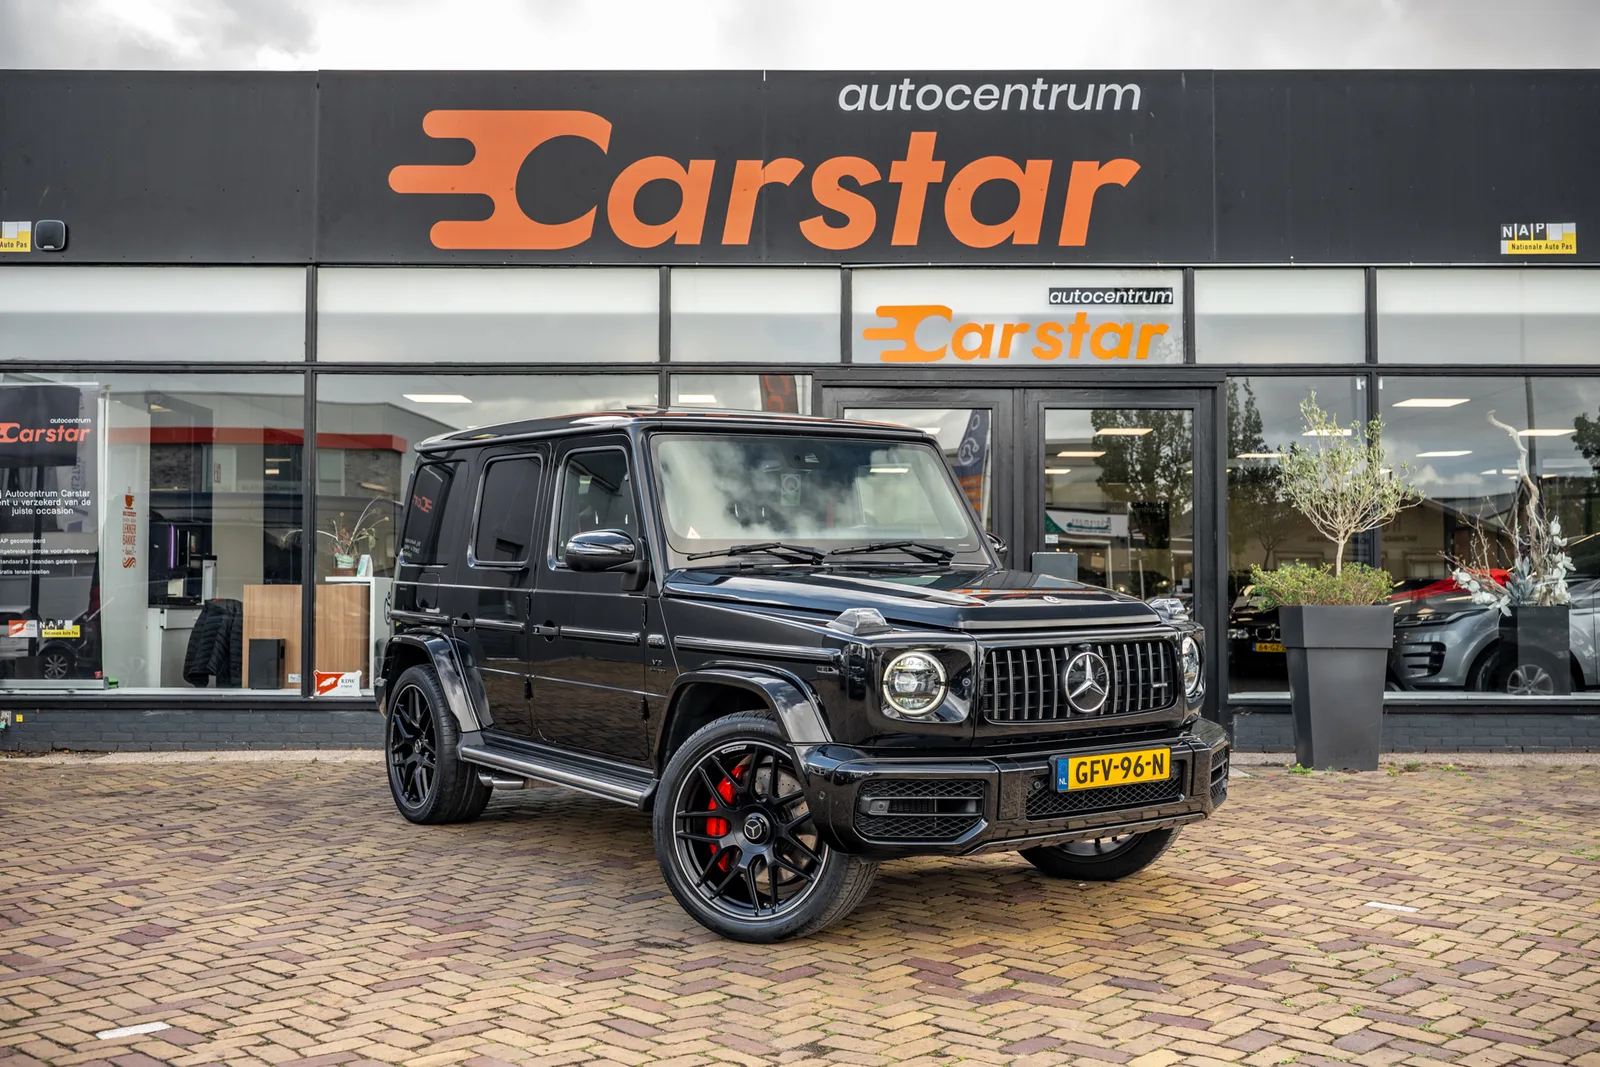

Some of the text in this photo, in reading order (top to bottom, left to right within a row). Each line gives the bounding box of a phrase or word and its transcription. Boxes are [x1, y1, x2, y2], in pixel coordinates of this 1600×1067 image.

[838, 77, 1141, 112] autocentrum
[389, 109, 1140, 251] Carstar
[16, 241, 28, 249] Pas
[1561, 242, 1573, 250] Pas
[1049, 289, 1173, 304] autocentrum
[862, 305, 1170, 361] Carstar
[0, 422, 91, 443] Carstar
[5, 489, 58, 498] Autocentrum
[60, 489, 91, 498] Carstar
[11, 507, 33, 517] juiste
[1075, 752, 1165, 785] GFV-96-N
[1058, 777, 1068, 786] NL
